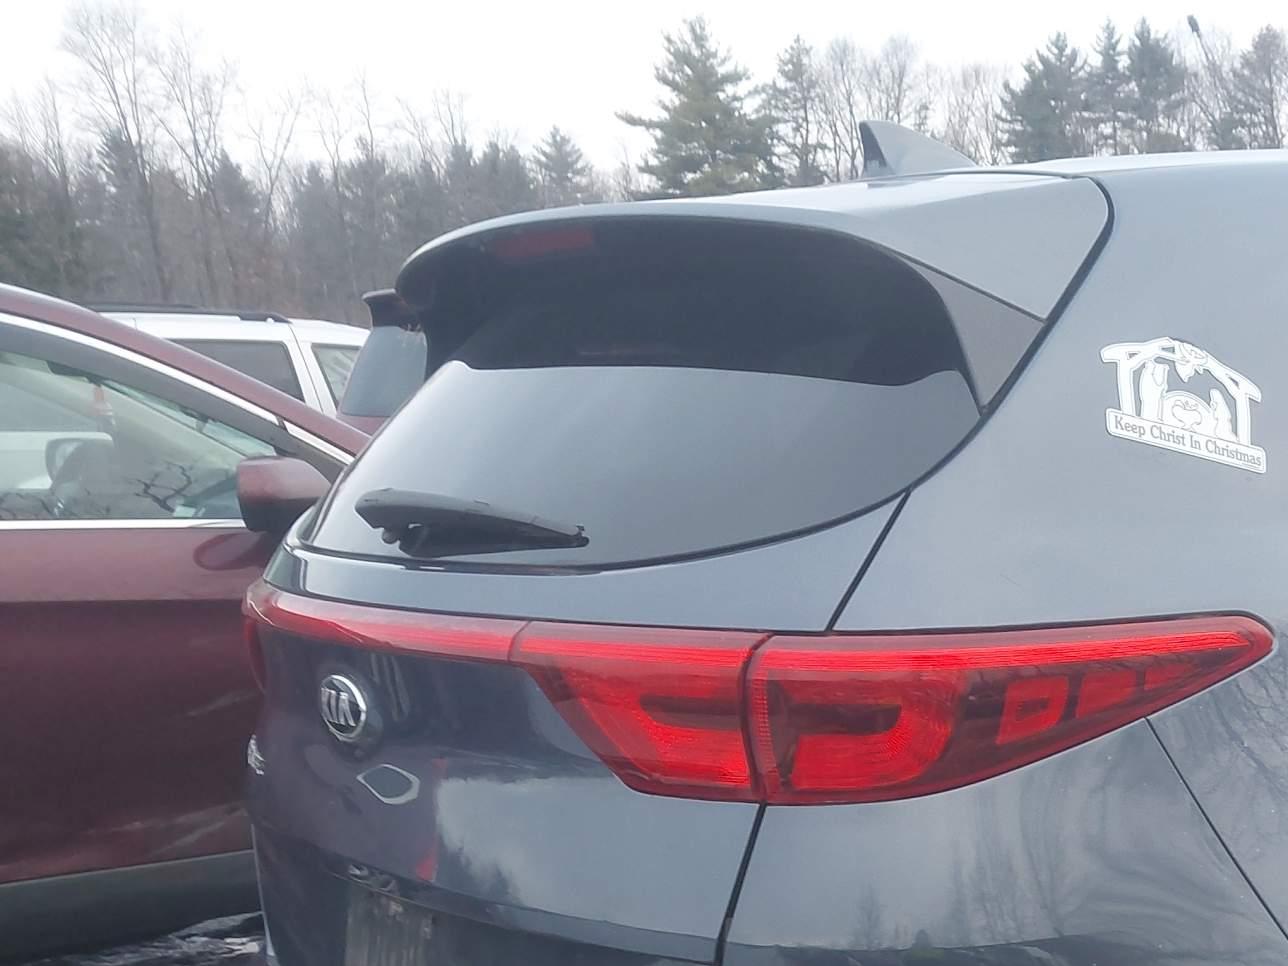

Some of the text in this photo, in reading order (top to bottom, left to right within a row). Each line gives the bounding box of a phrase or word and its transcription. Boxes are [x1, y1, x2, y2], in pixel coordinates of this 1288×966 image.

[1114, 415, 1262, 467] Keep Christ In Christmas
